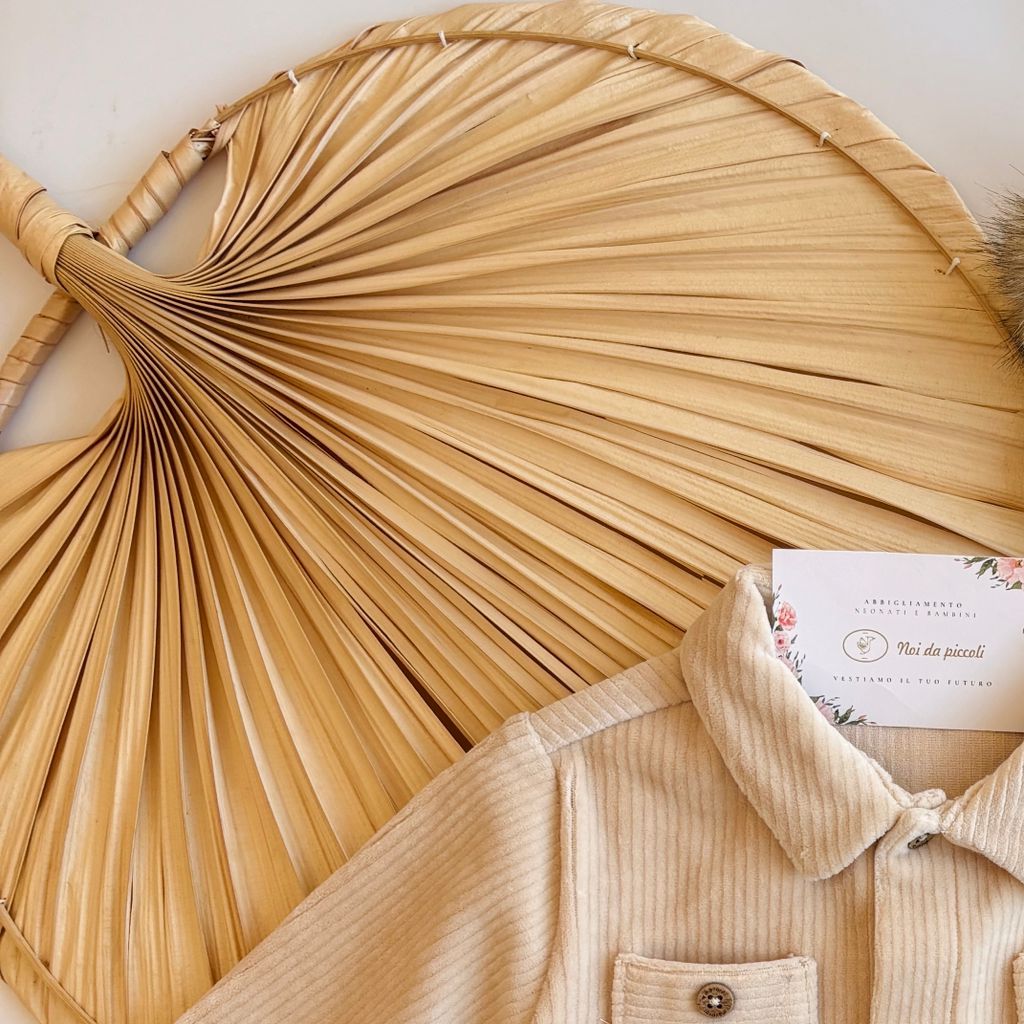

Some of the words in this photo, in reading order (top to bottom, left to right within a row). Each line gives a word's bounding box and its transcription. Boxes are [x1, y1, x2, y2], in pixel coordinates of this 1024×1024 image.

[864, 599, 963, 609] ABBIGLIAMENTO
[855, 608, 907, 616] NEONATI
[927, 610, 977, 619] BAMBINI
[897, 641, 923, 656] Noi
[923, 642, 941, 657] da
[943, 643, 986, 661] piccoli
[833, 675, 893, 684] VESTIAMO
[899, 677, 912, 685] IL
[918, 678, 941, 686] TUO
[947, 679, 993, 688] FUTURO
